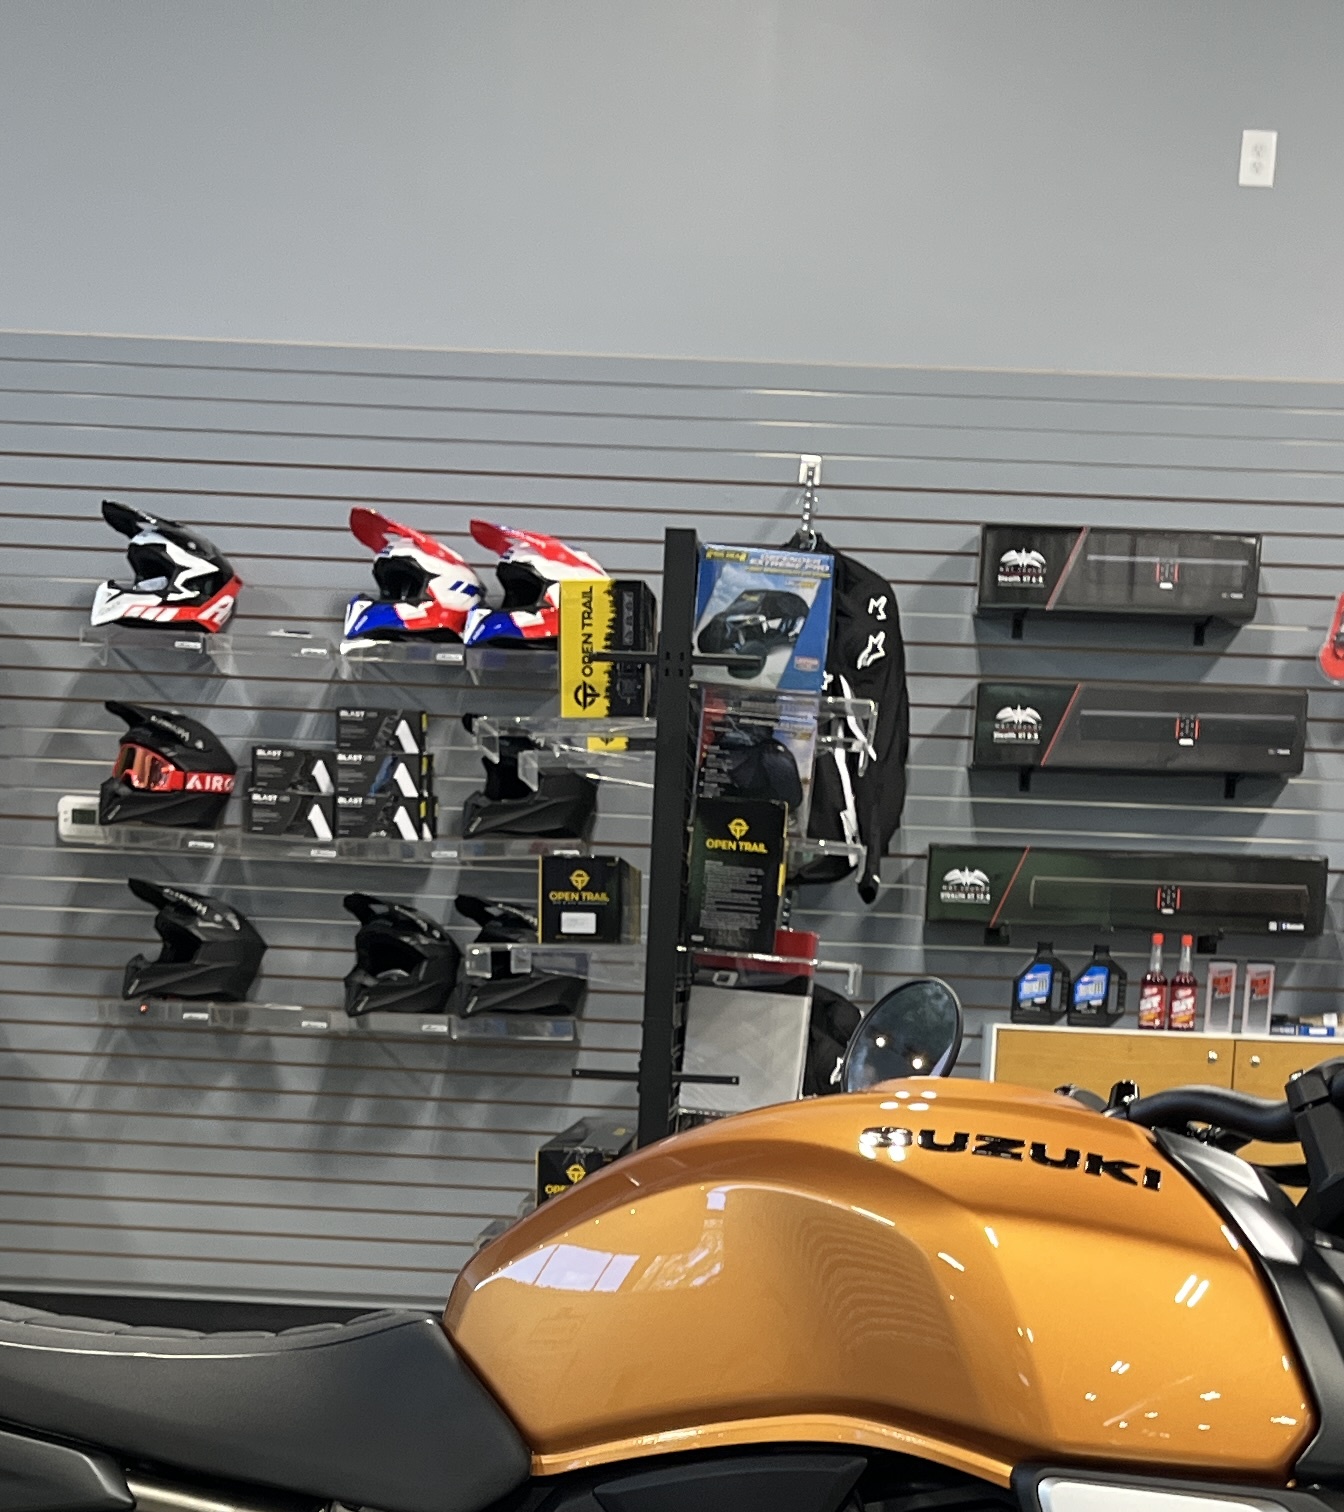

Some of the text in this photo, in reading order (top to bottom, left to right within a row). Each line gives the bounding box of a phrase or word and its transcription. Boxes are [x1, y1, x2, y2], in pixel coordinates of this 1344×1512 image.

[581, 585, 593, 678] OPEN TRAIL
[705, 838, 768, 854] OPEN TRAIL
[549, 890, 579, 901] OPEN
[858, 1125, 1163, 1192] SUZUKI
